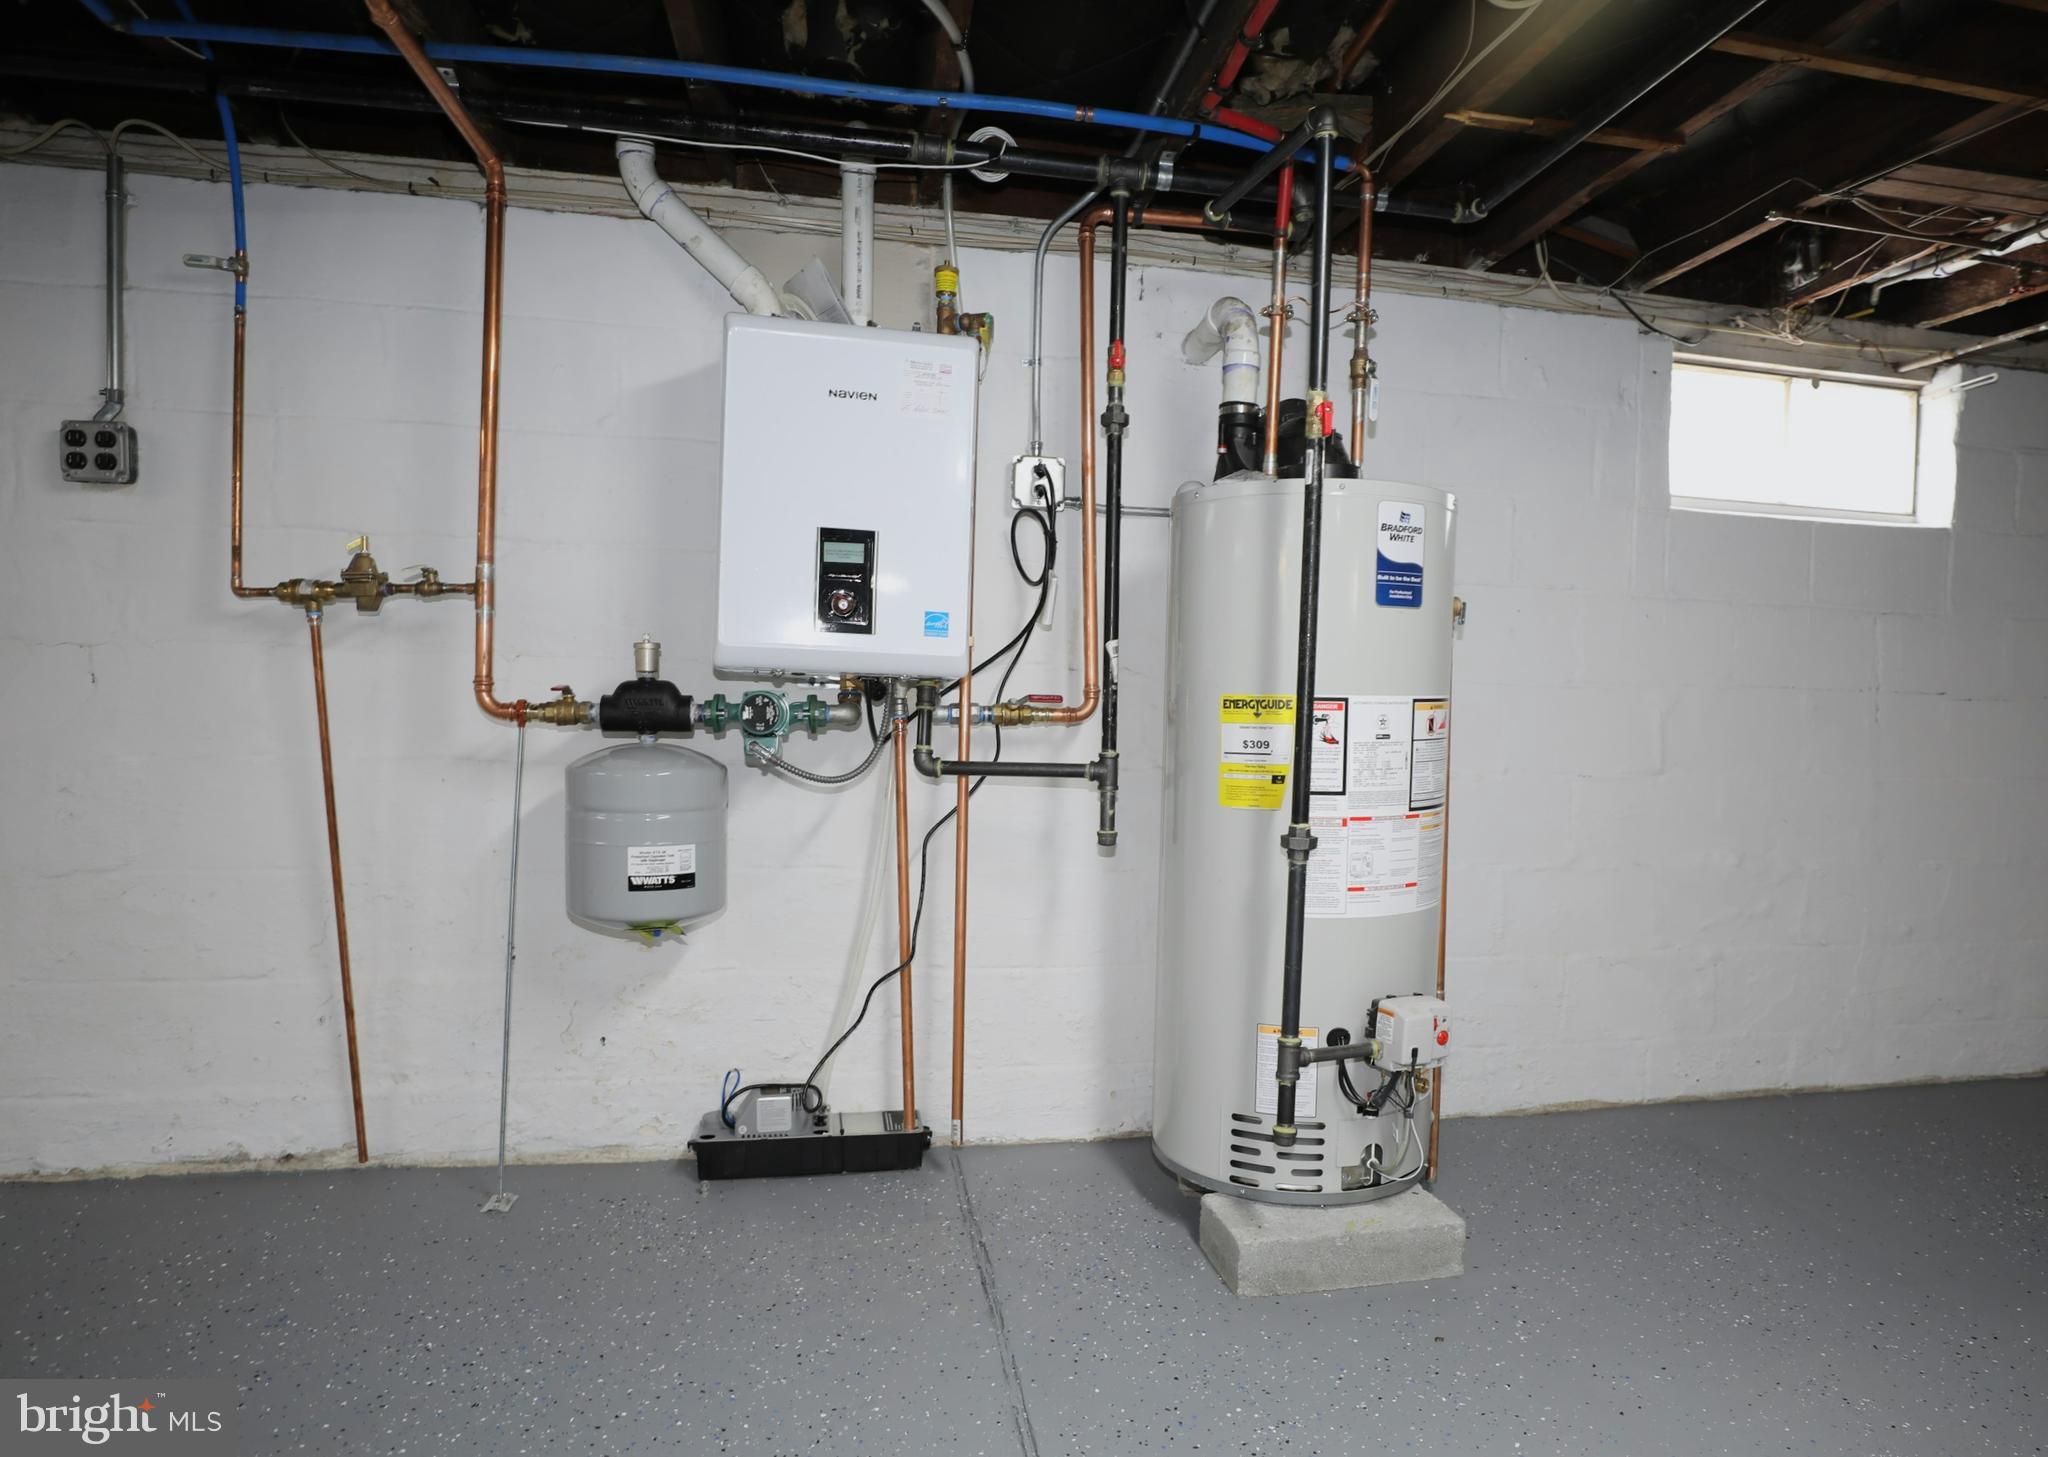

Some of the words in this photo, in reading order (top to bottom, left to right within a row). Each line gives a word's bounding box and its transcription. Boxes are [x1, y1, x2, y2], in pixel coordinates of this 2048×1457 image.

[1381, 523, 1423, 535] BRADFORD
[1389, 533, 1416, 543] WHITE
[1223, 699, 1293, 710] ENERGYGUIDE
[1242, 740, 1270, 750] $309
